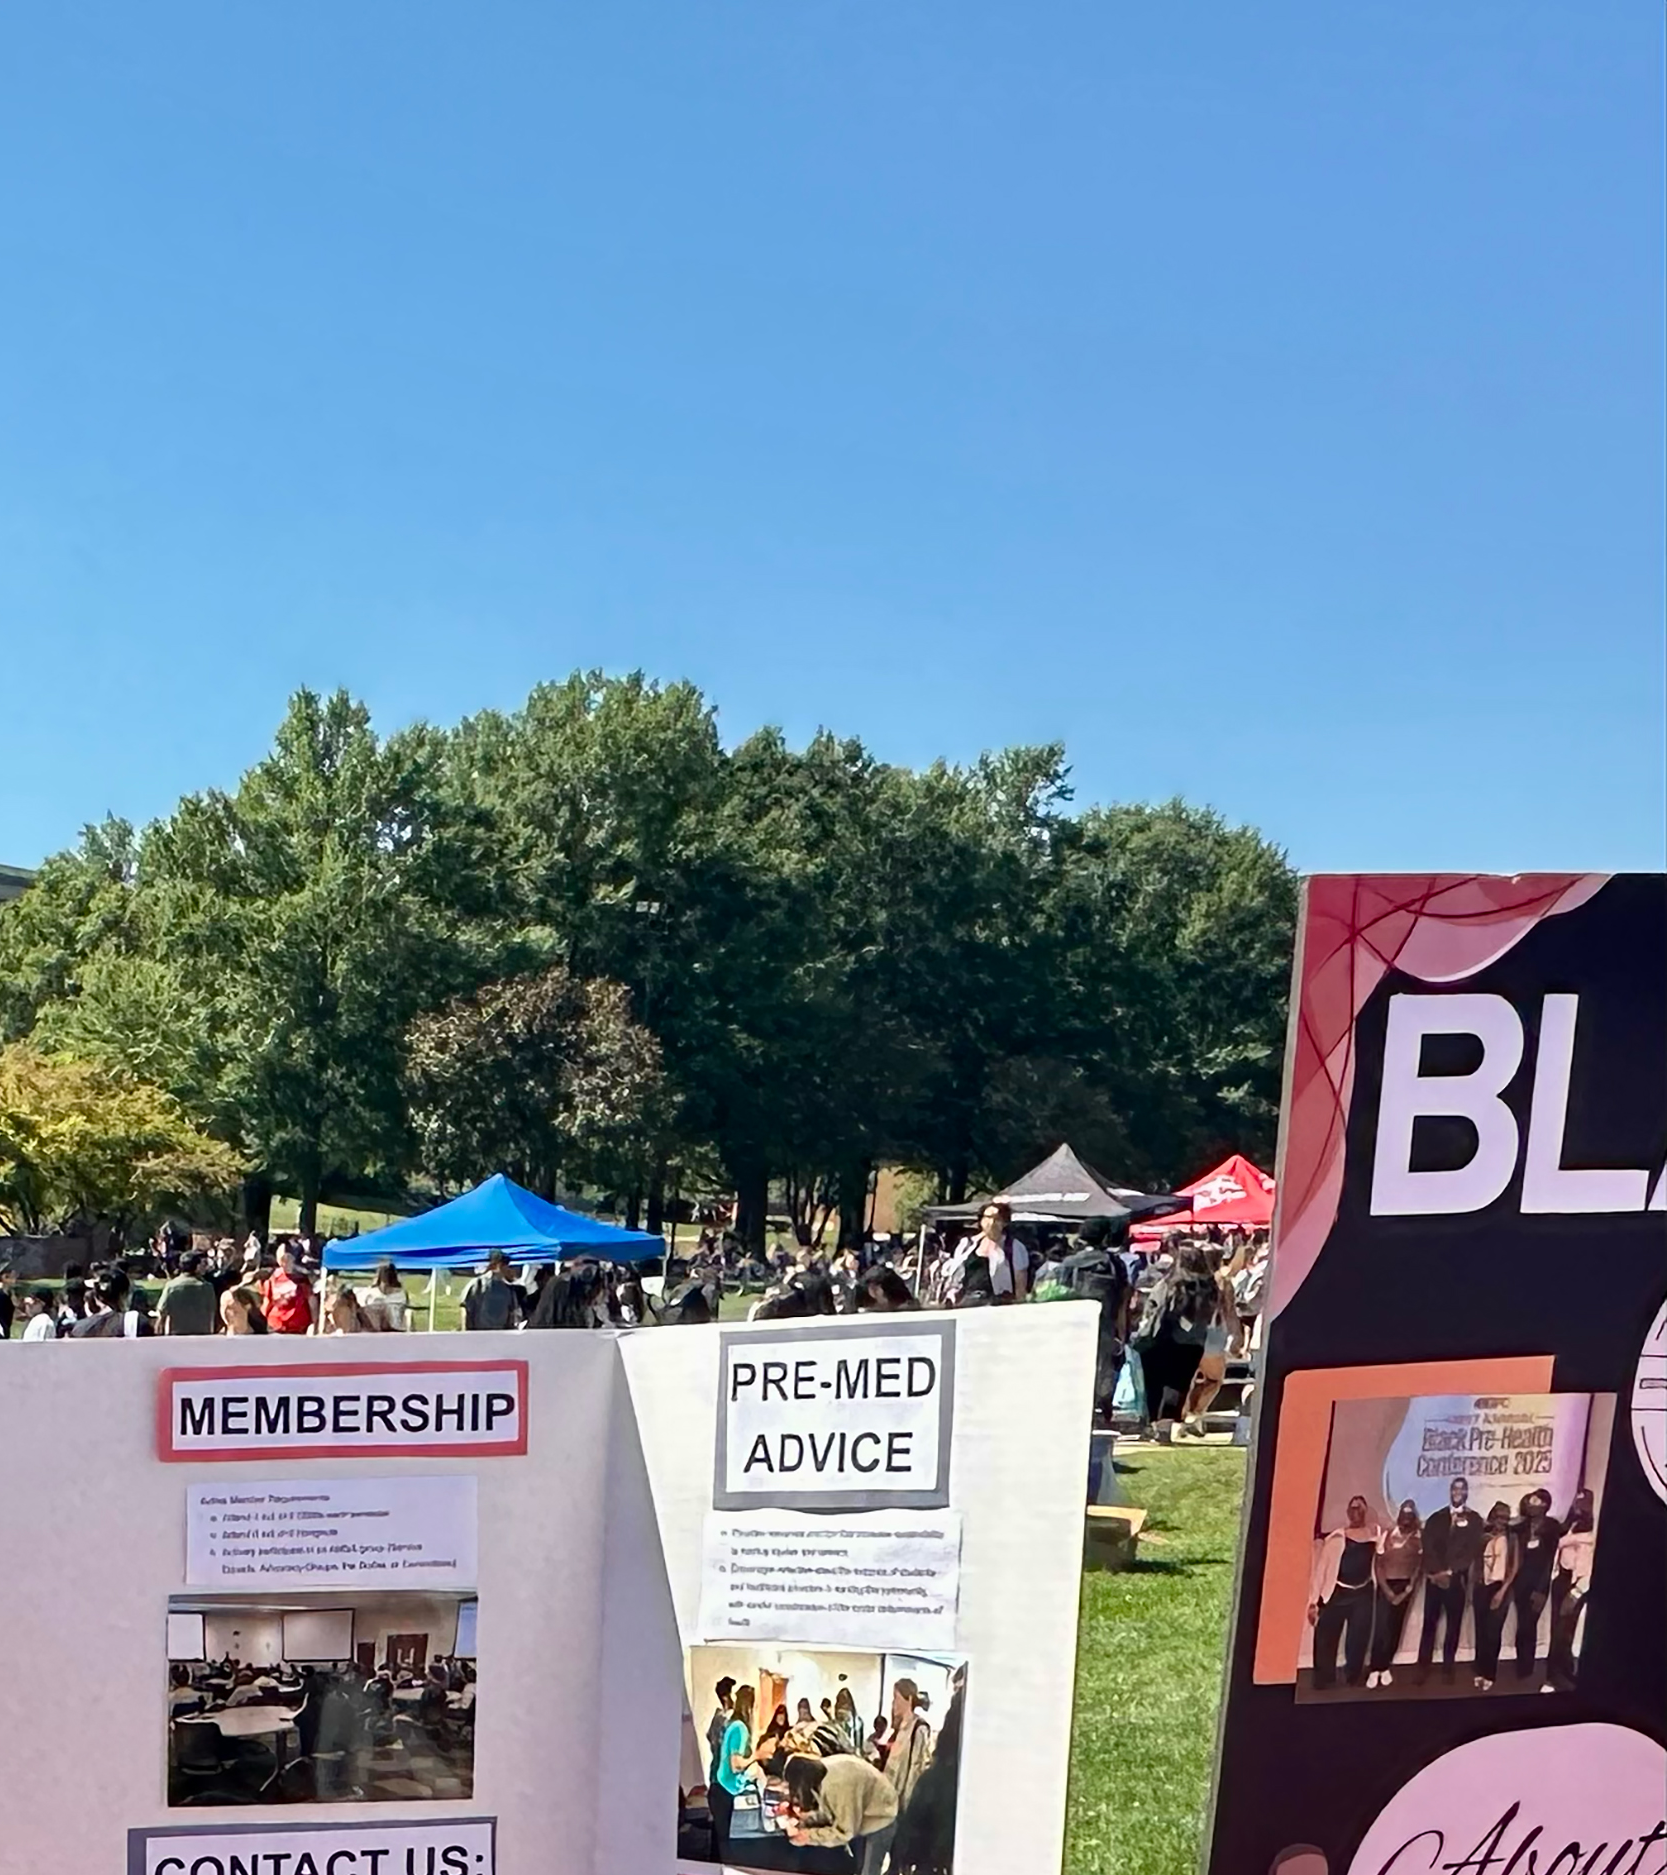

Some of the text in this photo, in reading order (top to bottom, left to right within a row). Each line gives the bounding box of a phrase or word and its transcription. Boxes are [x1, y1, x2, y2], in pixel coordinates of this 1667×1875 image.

[1370, 993, 1667, 1216] BL
[731, 1356, 937, 1402] PRE-MED
[179, 1392, 516, 1436] MEMBERSHIP
[743, 1431, 914, 1475] ADVICE
